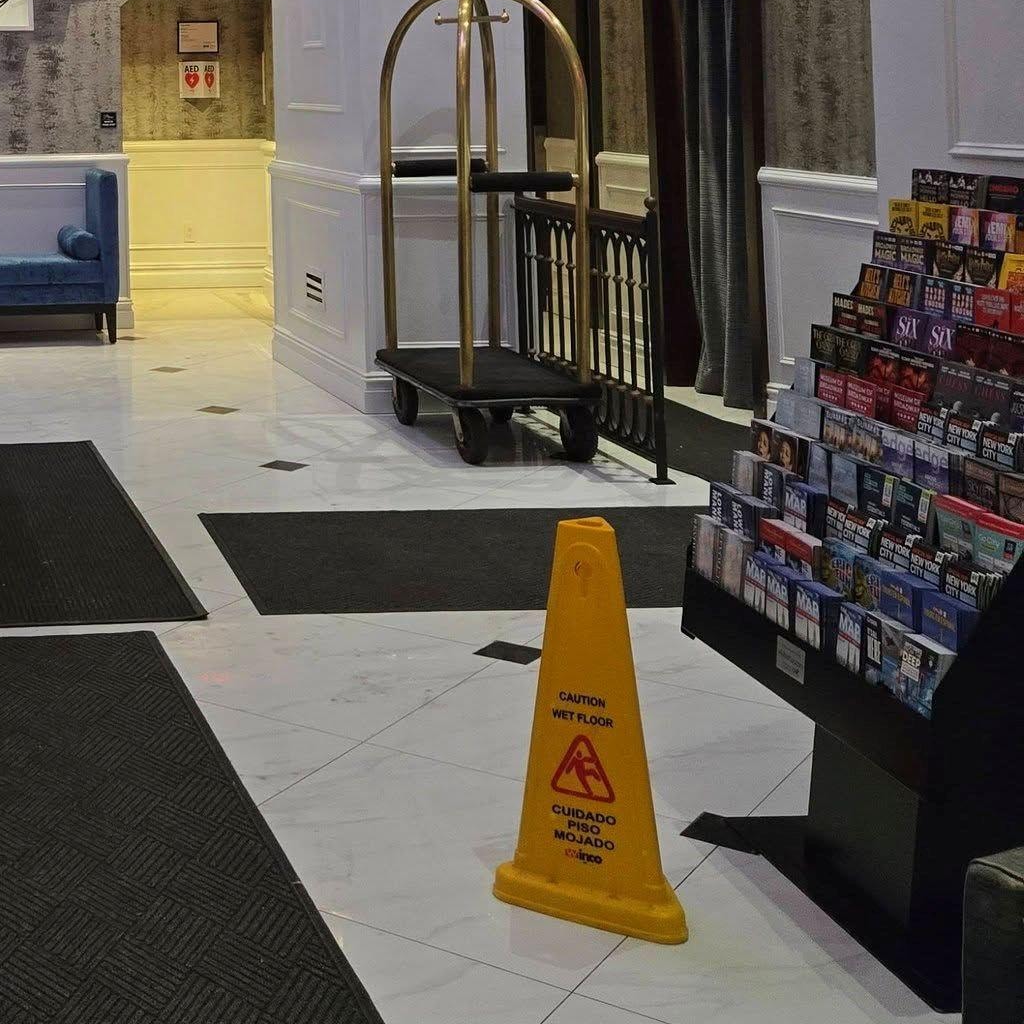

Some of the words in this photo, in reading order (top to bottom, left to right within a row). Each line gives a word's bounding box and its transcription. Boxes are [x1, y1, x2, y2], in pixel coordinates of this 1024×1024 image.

[184, 65, 199, 73] AED
[204, 65, 215, 73] AED
[876, 248, 897, 262] MAGIC
[901, 250, 925, 266] MAGIC
[848, 389, 873, 404] BROADWAY
[946, 433, 960, 445] CITY
[948, 422, 962, 435] NEW
[962, 428, 978, 439] YORK
[982, 447, 997, 460] CITY
[983, 436, 997, 449] NEW
[998, 442, 1014, 454] YORK
[785, 490, 807, 515] MAP
[843, 528, 855, 541] CITY
[845, 518, 856, 532] NEW
[857, 525, 871, 539] YORK
[880, 546, 894, 562] CITY
[881, 537, 895, 551] NEW
[895, 542, 911, 558] YORK
[910, 563, 924, 577] CITY
[911, 552, 924, 567] NEW
[925, 558, 940, 574] YORK
[745, 559, 767, 588] MAP
[767, 574, 788, 604] MAP
[945, 584, 959, 598] CITY
[946, 572, 960, 588] NEW
[960, 579, 977, 597] YORK
[796, 590, 820, 622] MAP
[839, 611, 861, 643] MAP
[902, 651, 921, 667] DEEP
[559, 691, 606, 708] CAUTION
[552, 708, 575, 721] WET
[577, 710, 614, 728] FLOOR
[552, 804, 616, 825] CUIDADO
[568, 820, 600, 835] PISO
[554, 829, 615, 850] MOJADO
